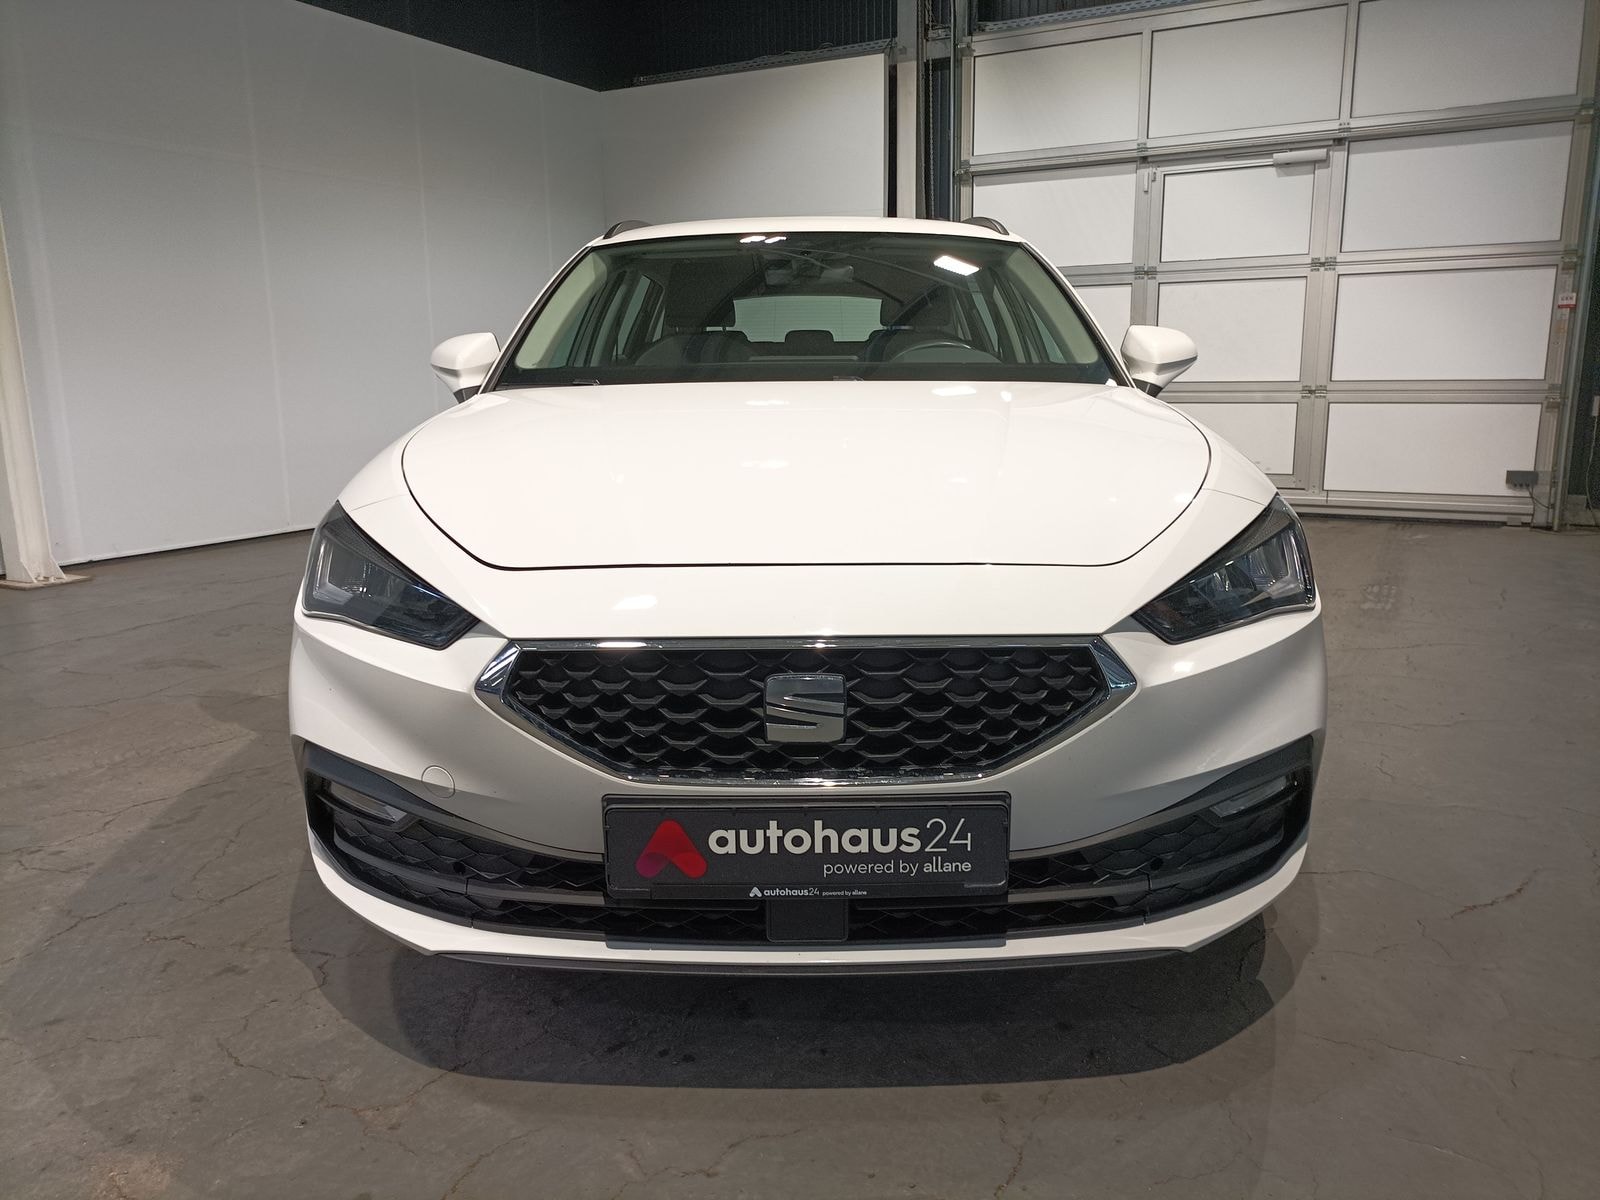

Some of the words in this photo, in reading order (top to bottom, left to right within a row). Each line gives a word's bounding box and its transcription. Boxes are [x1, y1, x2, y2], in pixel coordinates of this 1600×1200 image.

[707, 817, 972, 855] autohaus24
[823, 859, 894, 878] powered
[899, 859, 919, 877] by
[923, 856, 972, 873] allane
[763, 887, 820, 897] autohaus24
